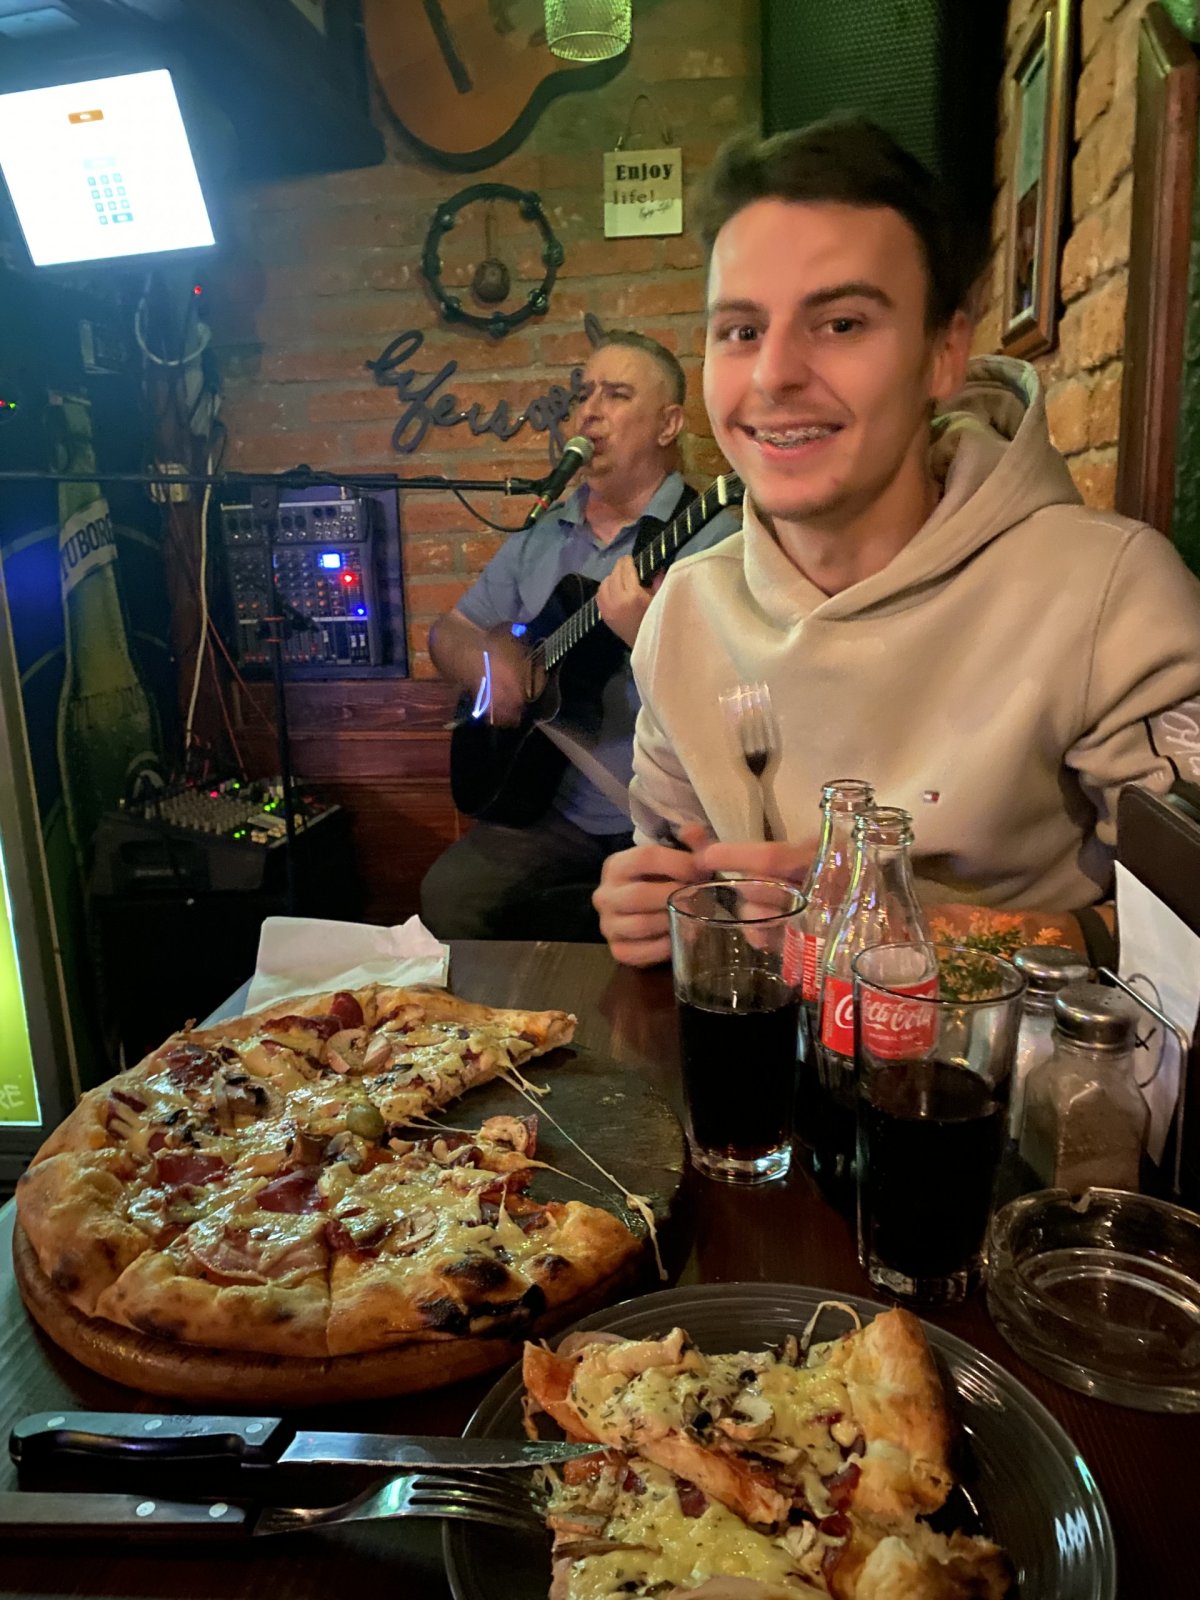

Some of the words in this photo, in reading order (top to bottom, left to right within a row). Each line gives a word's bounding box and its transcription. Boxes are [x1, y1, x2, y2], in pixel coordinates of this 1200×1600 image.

[616, 163, 673, 181] Enjoy
[612, 190, 655, 205] life!
[366, 329, 458, 453] life
